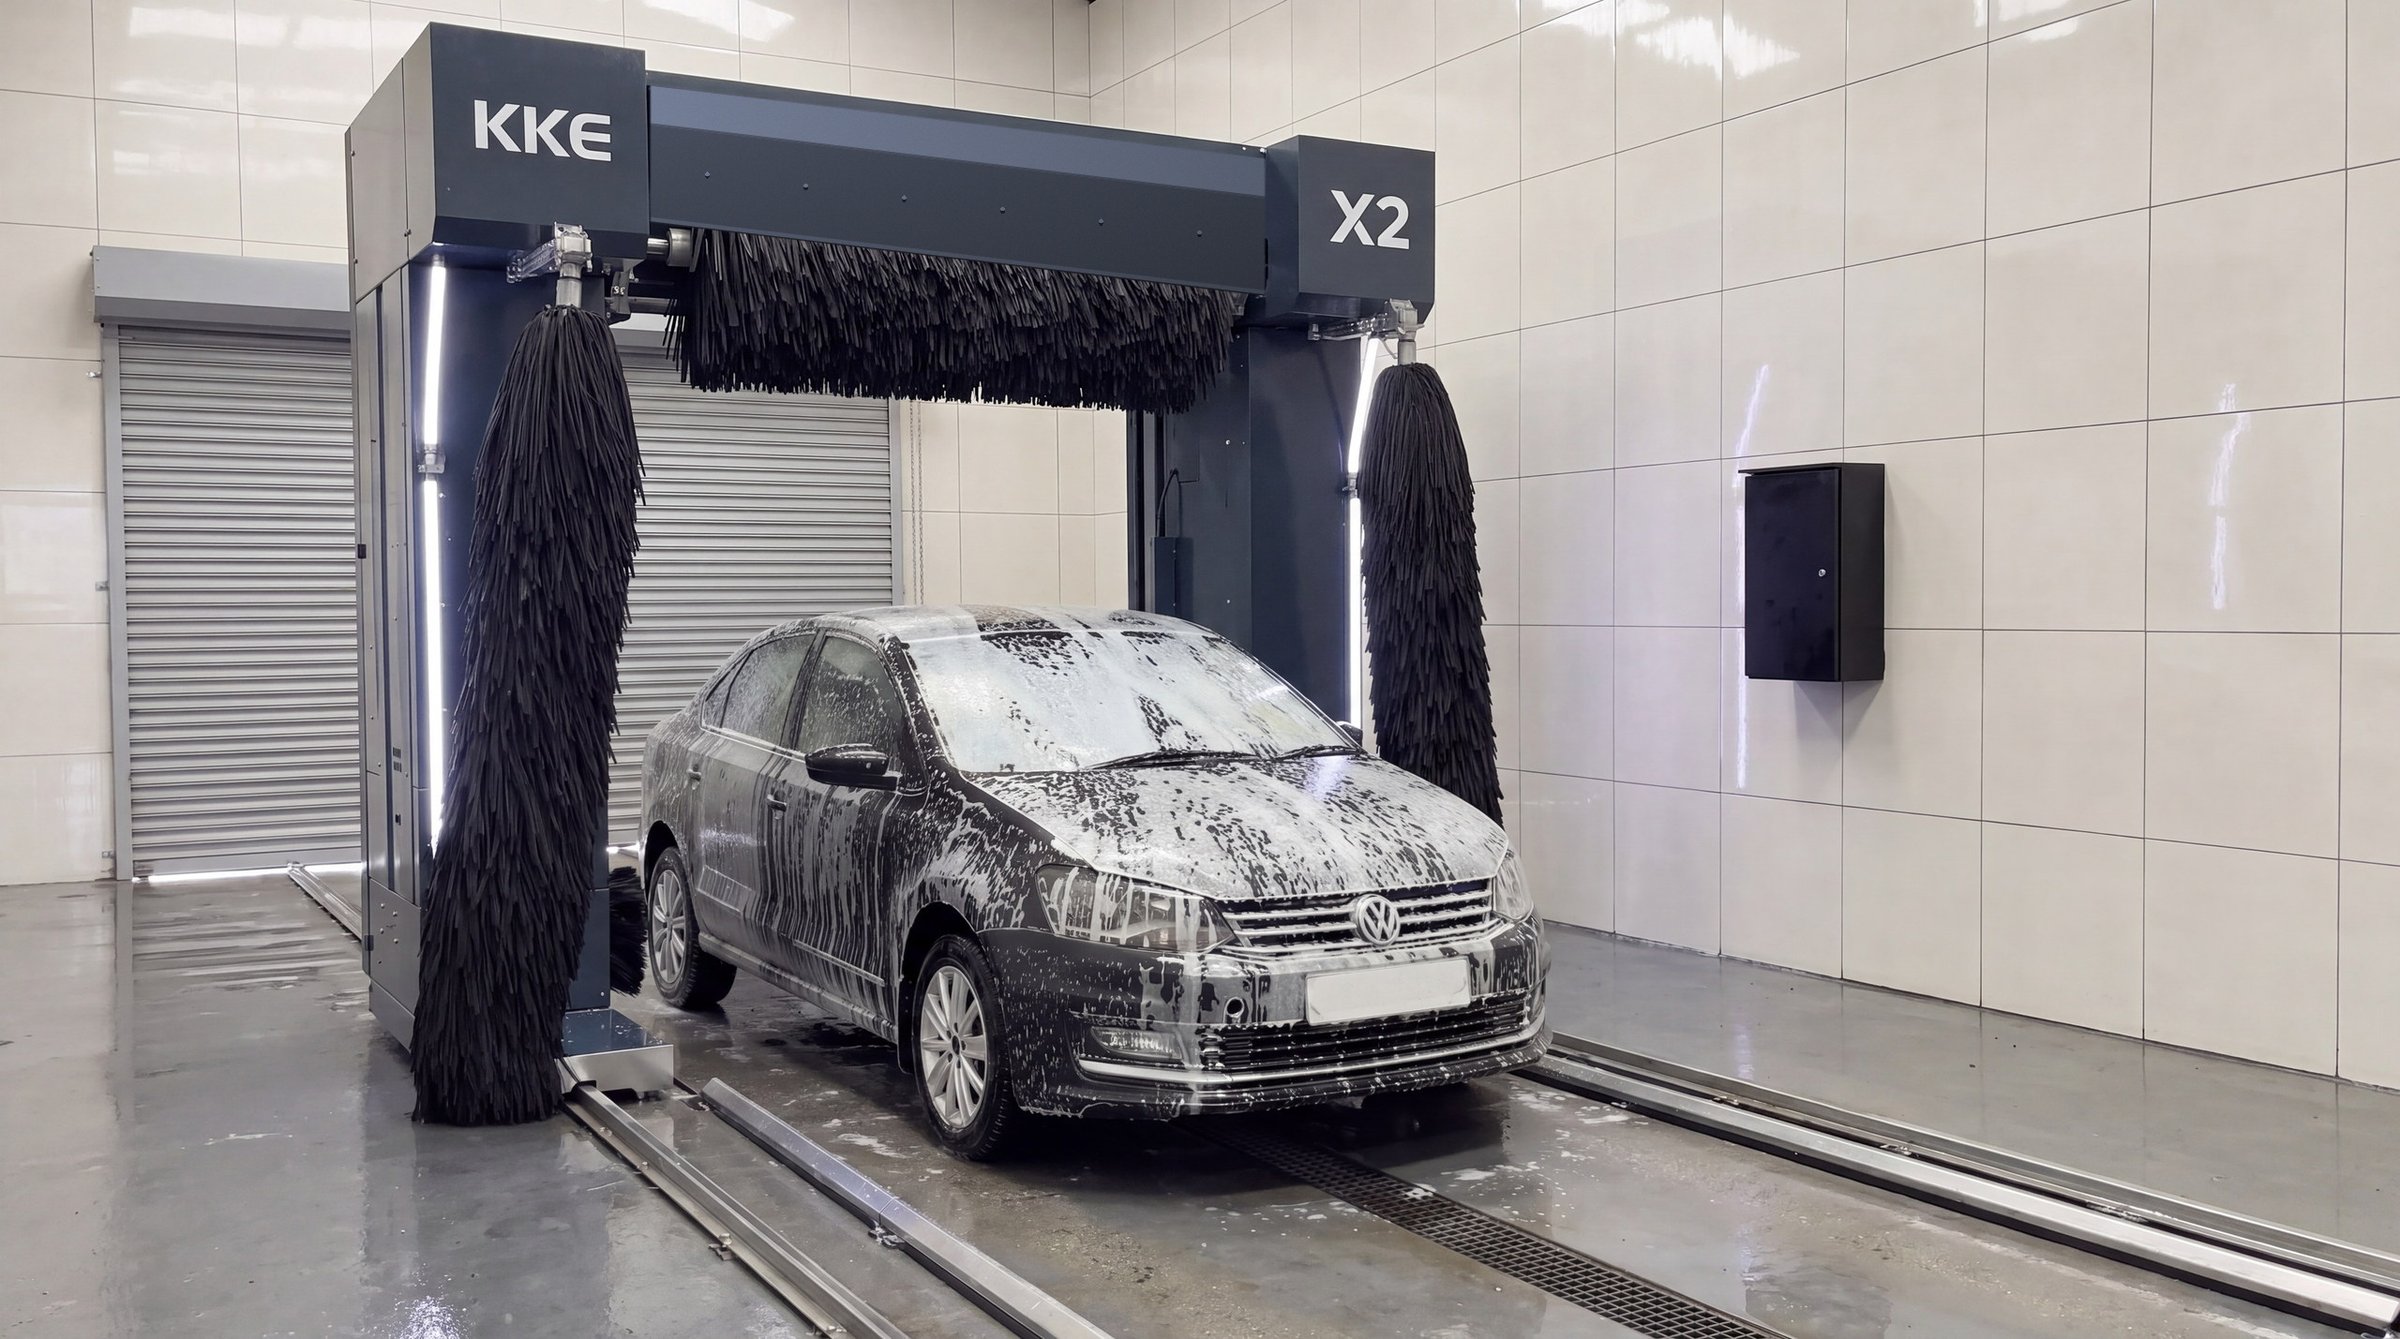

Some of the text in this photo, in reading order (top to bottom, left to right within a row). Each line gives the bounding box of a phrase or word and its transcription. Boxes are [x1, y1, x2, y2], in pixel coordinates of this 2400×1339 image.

[474, 99, 612, 162] KKE
[1329, 189, 1410, 250] X2
[1359, 896, 1398, 944] VW
